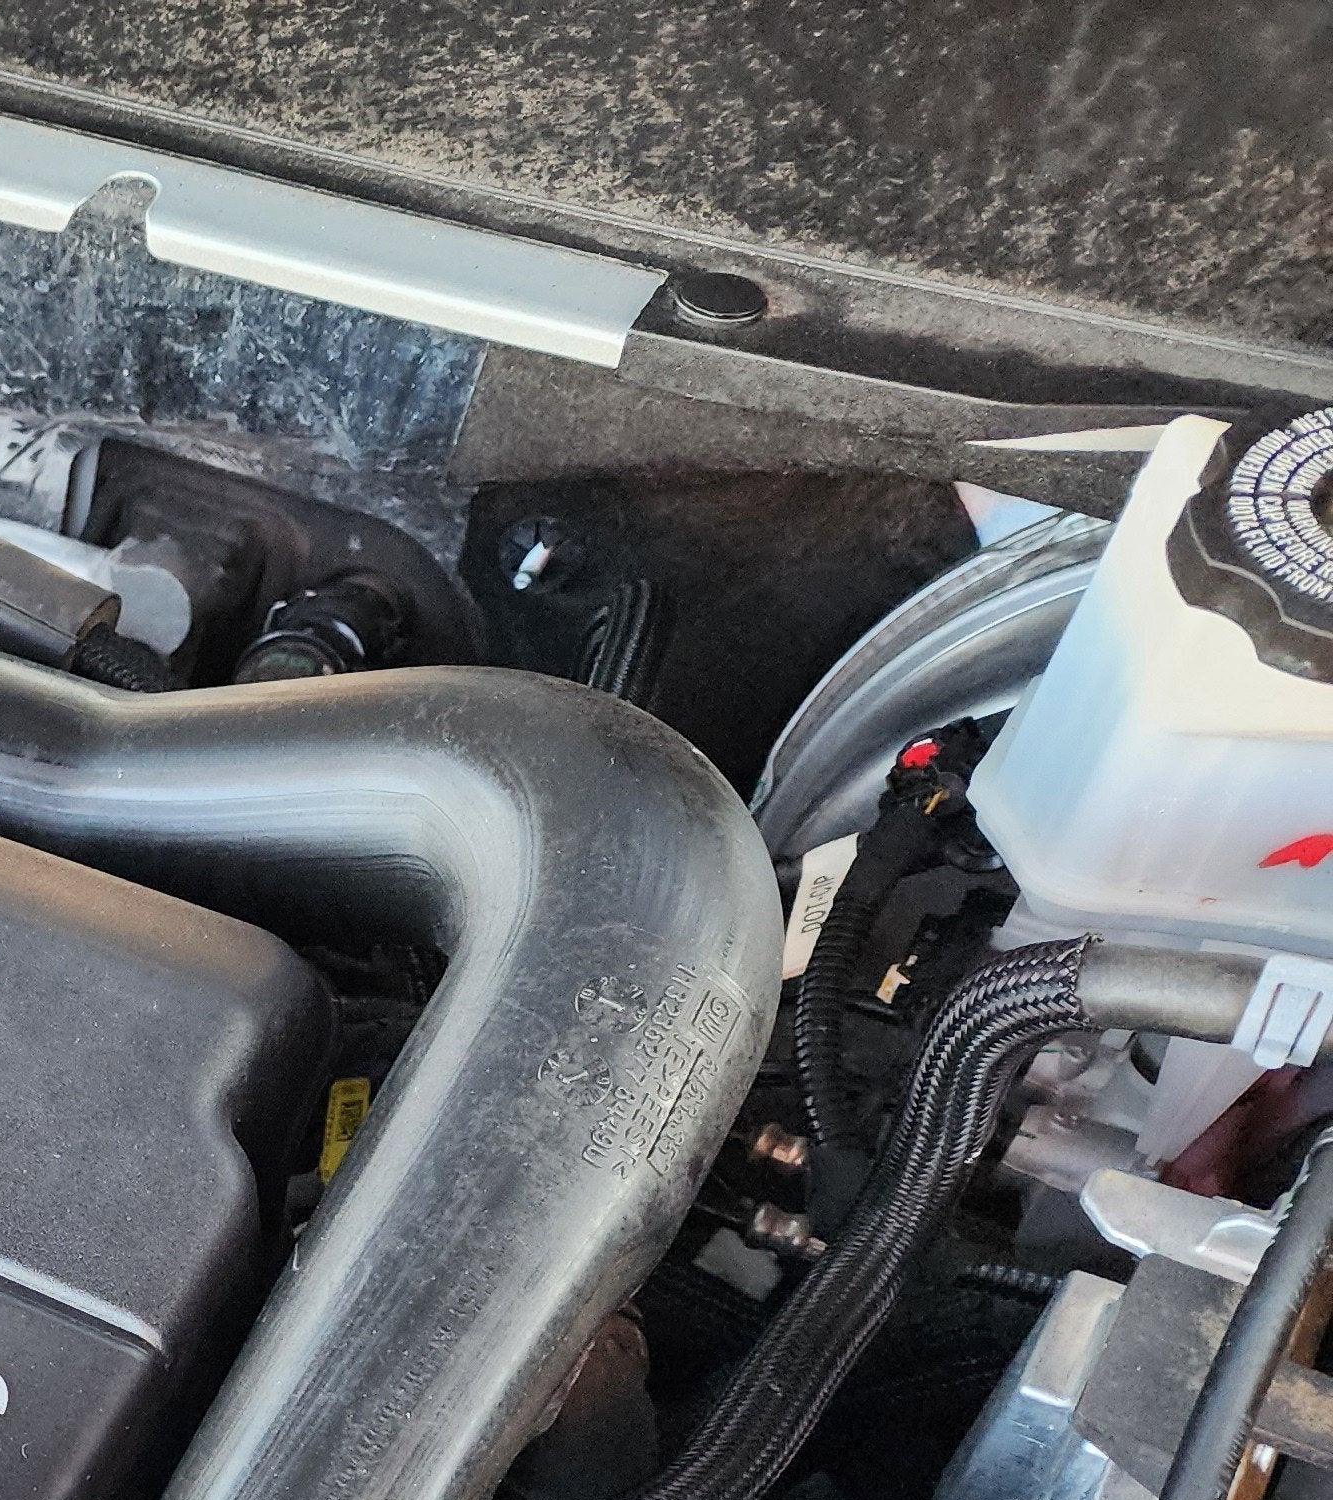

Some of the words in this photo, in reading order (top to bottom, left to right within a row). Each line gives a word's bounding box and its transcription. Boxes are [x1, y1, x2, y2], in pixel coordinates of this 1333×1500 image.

[1257, 495, 1286, 520] CAP
[1238, 528, 1287, 571] FLUID
[1272, 561, 1333, 600] FROM
[1265, 520, 1326, 571] BEFORE
[699, 996, 730, 1044] GM
